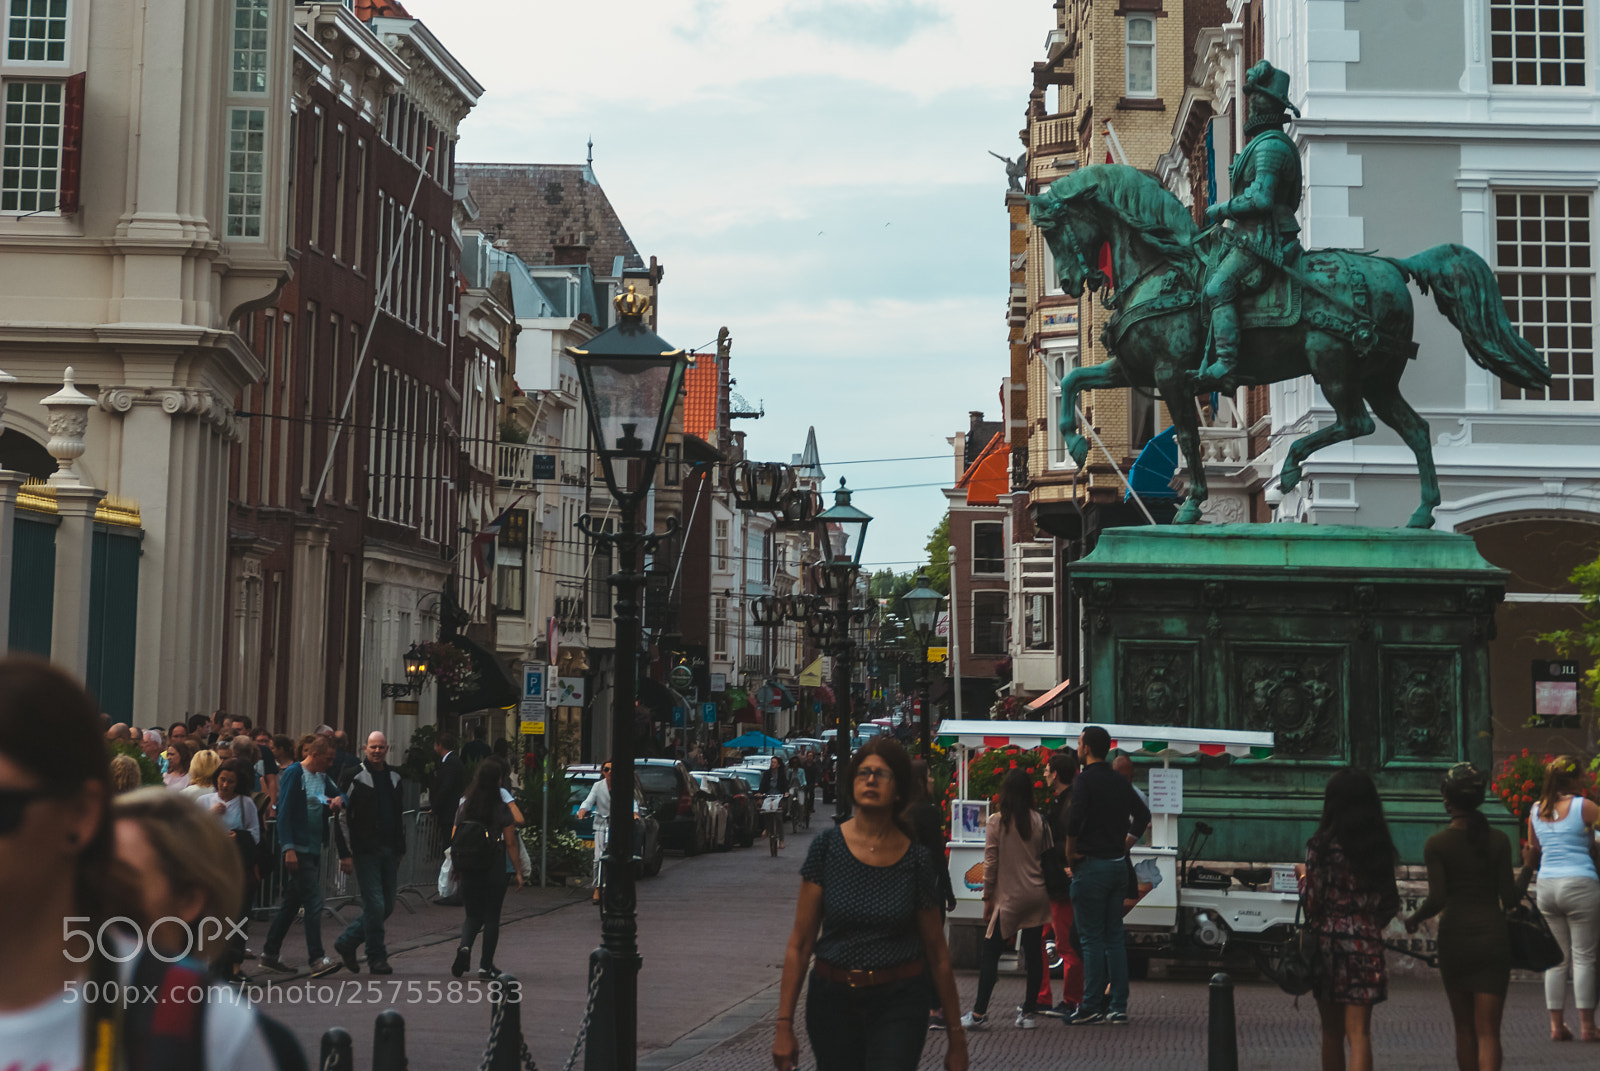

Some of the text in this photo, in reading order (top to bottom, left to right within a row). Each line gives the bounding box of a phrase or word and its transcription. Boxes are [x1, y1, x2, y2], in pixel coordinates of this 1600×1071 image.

[1562, 666, 1576, 674] JLL
[530, 677, 538, 688] P
[705, 704, 713, 714] P
[675, 712, 681, 721] P
